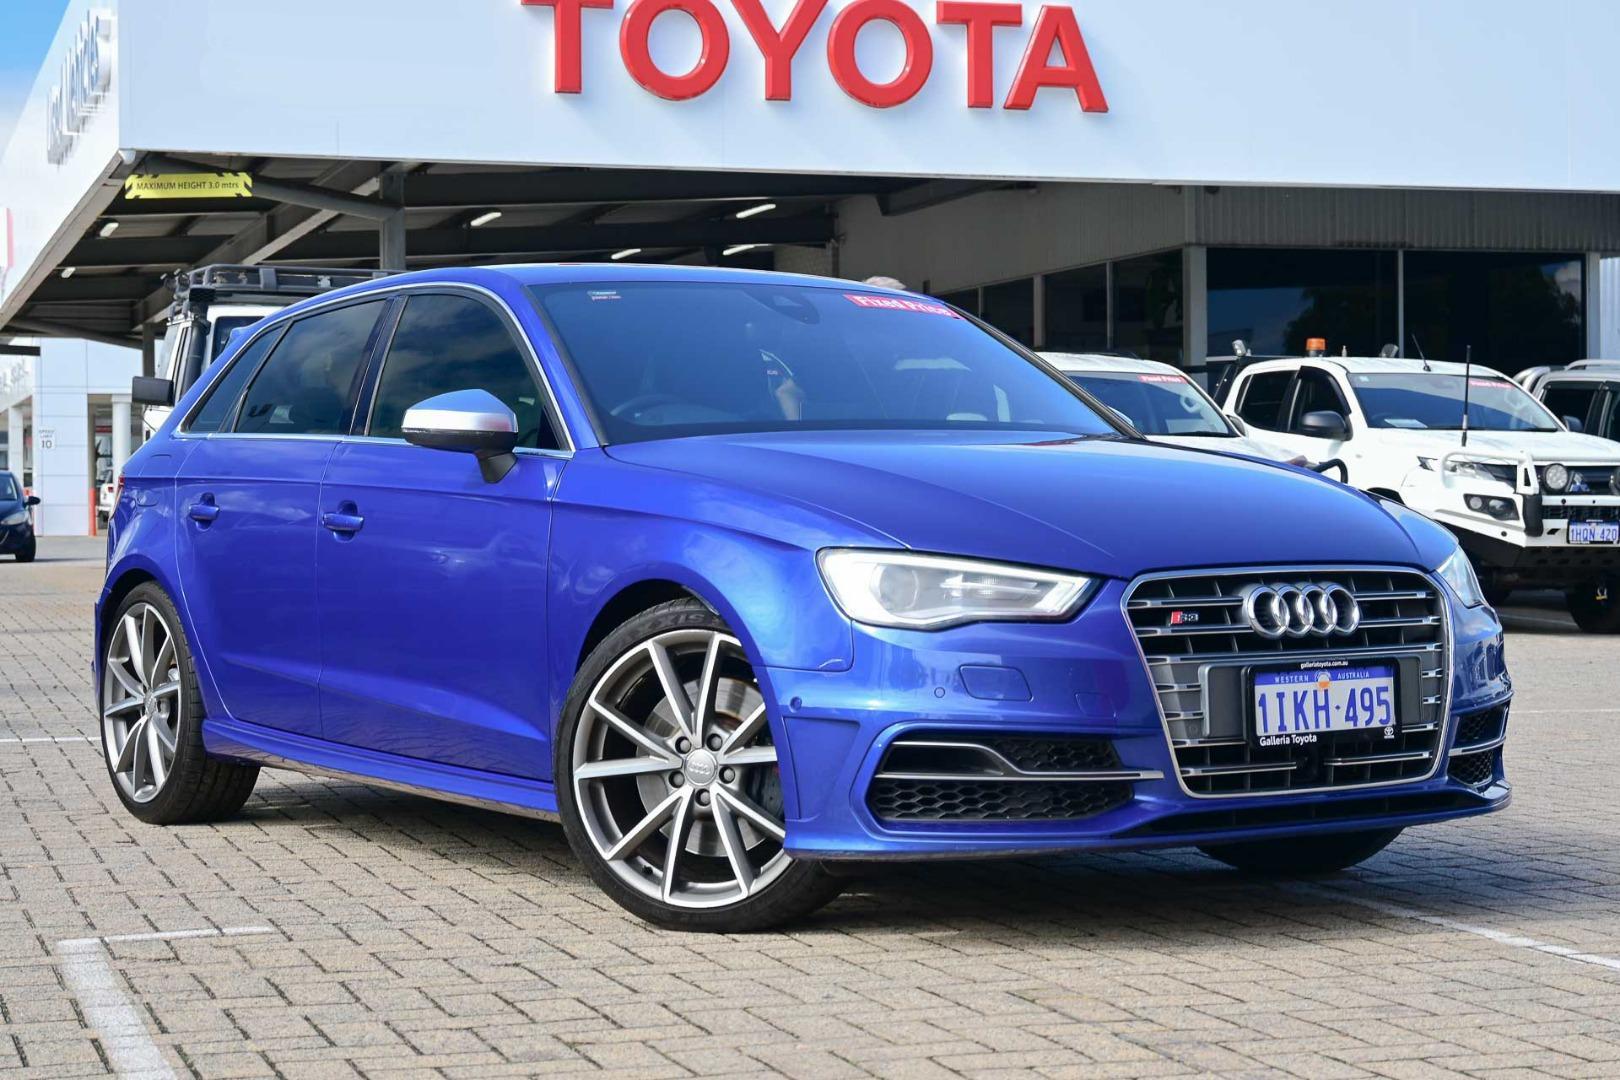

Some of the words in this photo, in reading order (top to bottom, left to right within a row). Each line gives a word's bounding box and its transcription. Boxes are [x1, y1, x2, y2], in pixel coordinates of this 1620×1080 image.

[521, 0, 1109, 112] TOYOTA
[137, 182, 175, 190] MAXIMUM
[178, 182, 206, 190] HEIGHT
[209, 182, 220, 190] 3.0
[41, 440, 53, 449] 10
[1600, 528, 1617, 541] 420
[1274, 674, 1309, 684] WESTERN
[1337, 671, 1370, 680] AUSTRALIA
[1259, 734, 1290, 747] Galleria
[1291, 733, 1318, 746] Toyota
